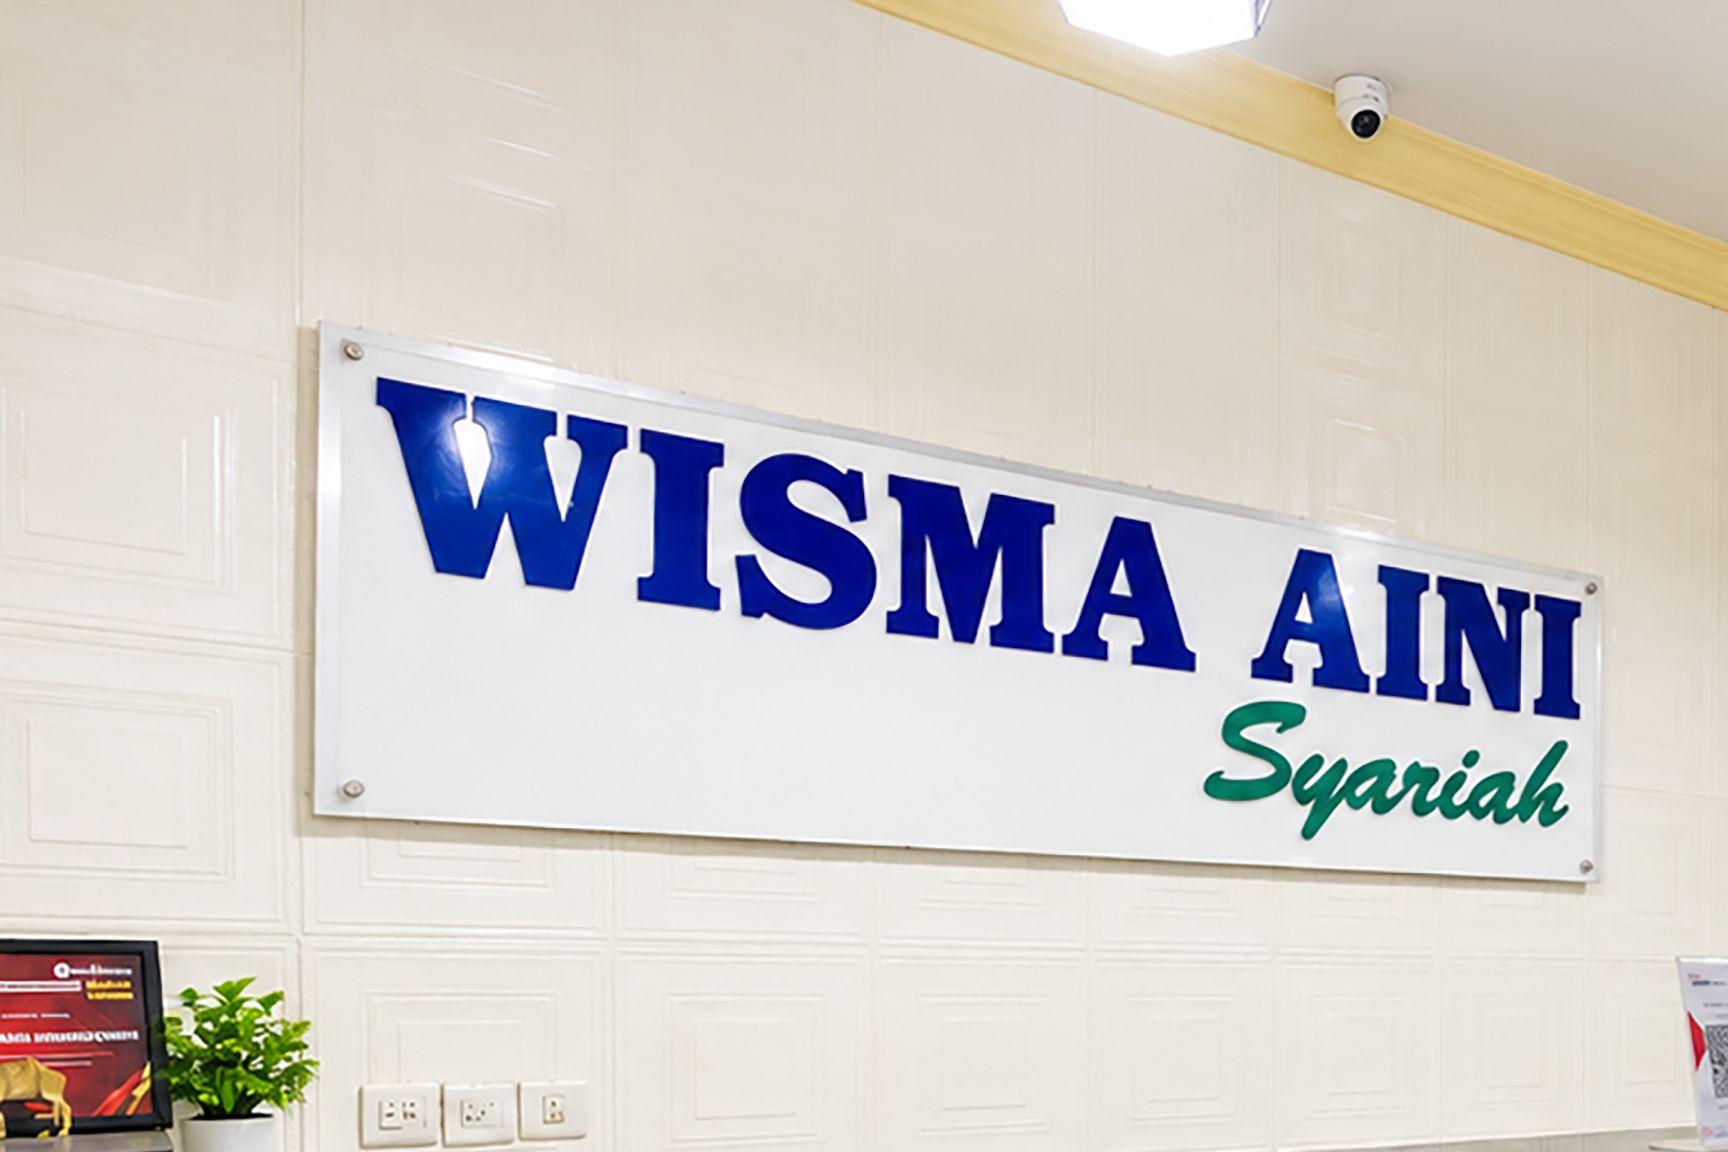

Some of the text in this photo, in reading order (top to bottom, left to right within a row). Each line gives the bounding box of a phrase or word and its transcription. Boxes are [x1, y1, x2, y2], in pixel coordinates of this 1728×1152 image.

[375, 377, 1582, 720] WISMA AINI
[1203, 701, 1570, 841] Syariah
